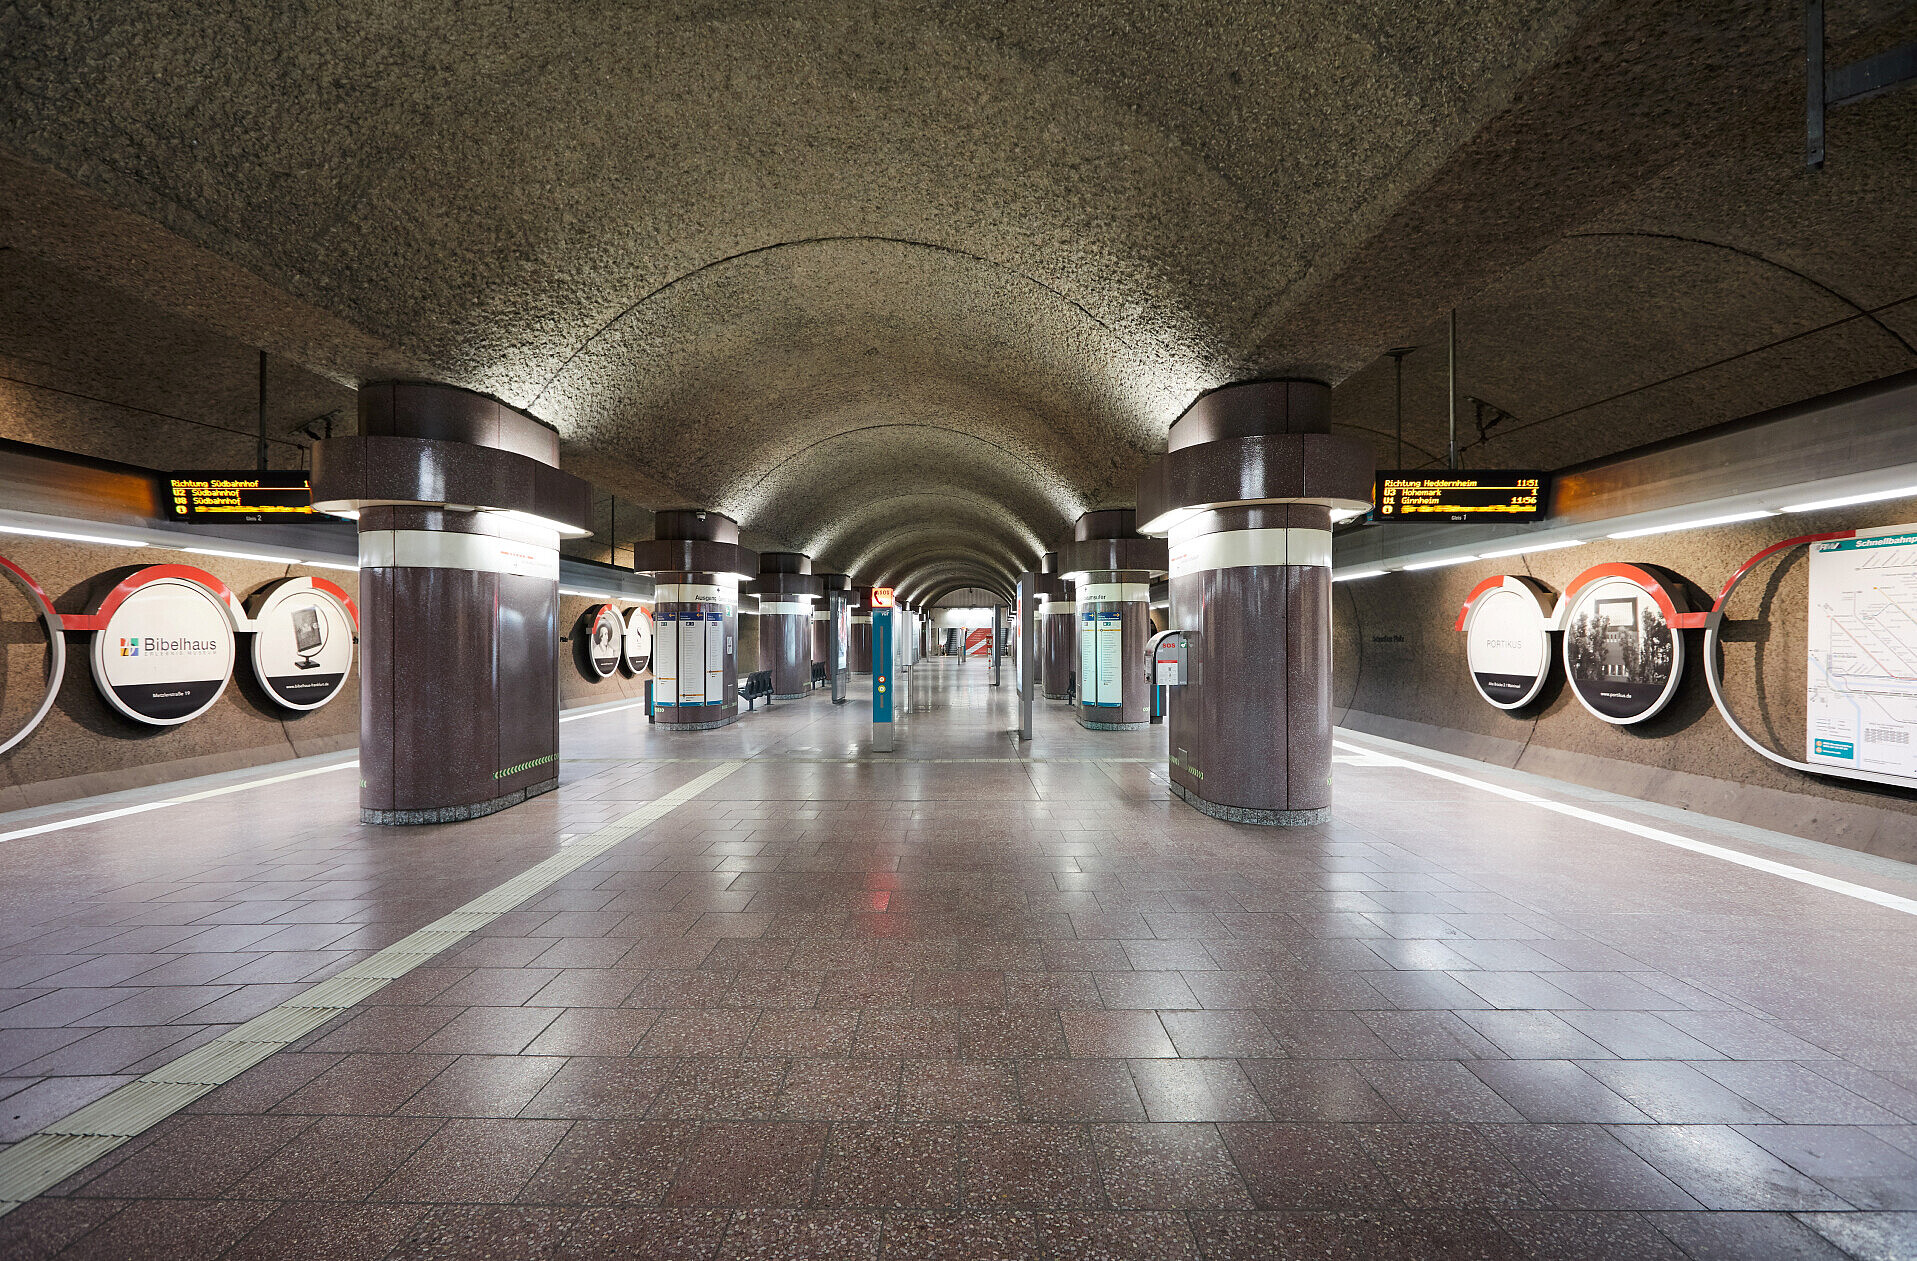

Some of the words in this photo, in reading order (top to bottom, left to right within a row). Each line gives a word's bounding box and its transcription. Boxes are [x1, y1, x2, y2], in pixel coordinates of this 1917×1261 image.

[171, 480, 209, 488] Richtung
[211, 480, 259, 488] Südbahnhof
[1384, 480, 1421, 488] Richtung
[1516, 479, 1539, 487] 11:51
[173, 489, 187, 497] U2
[191, 489, 240, 498] Südbahnhof
[174, 497, 188, 505] U8
[193, 497, 241, 506] Südbahnhof
[144, 637, 217, 652] Bibelhaus
[1486, 639, 1522, 649] PORTIKUS
